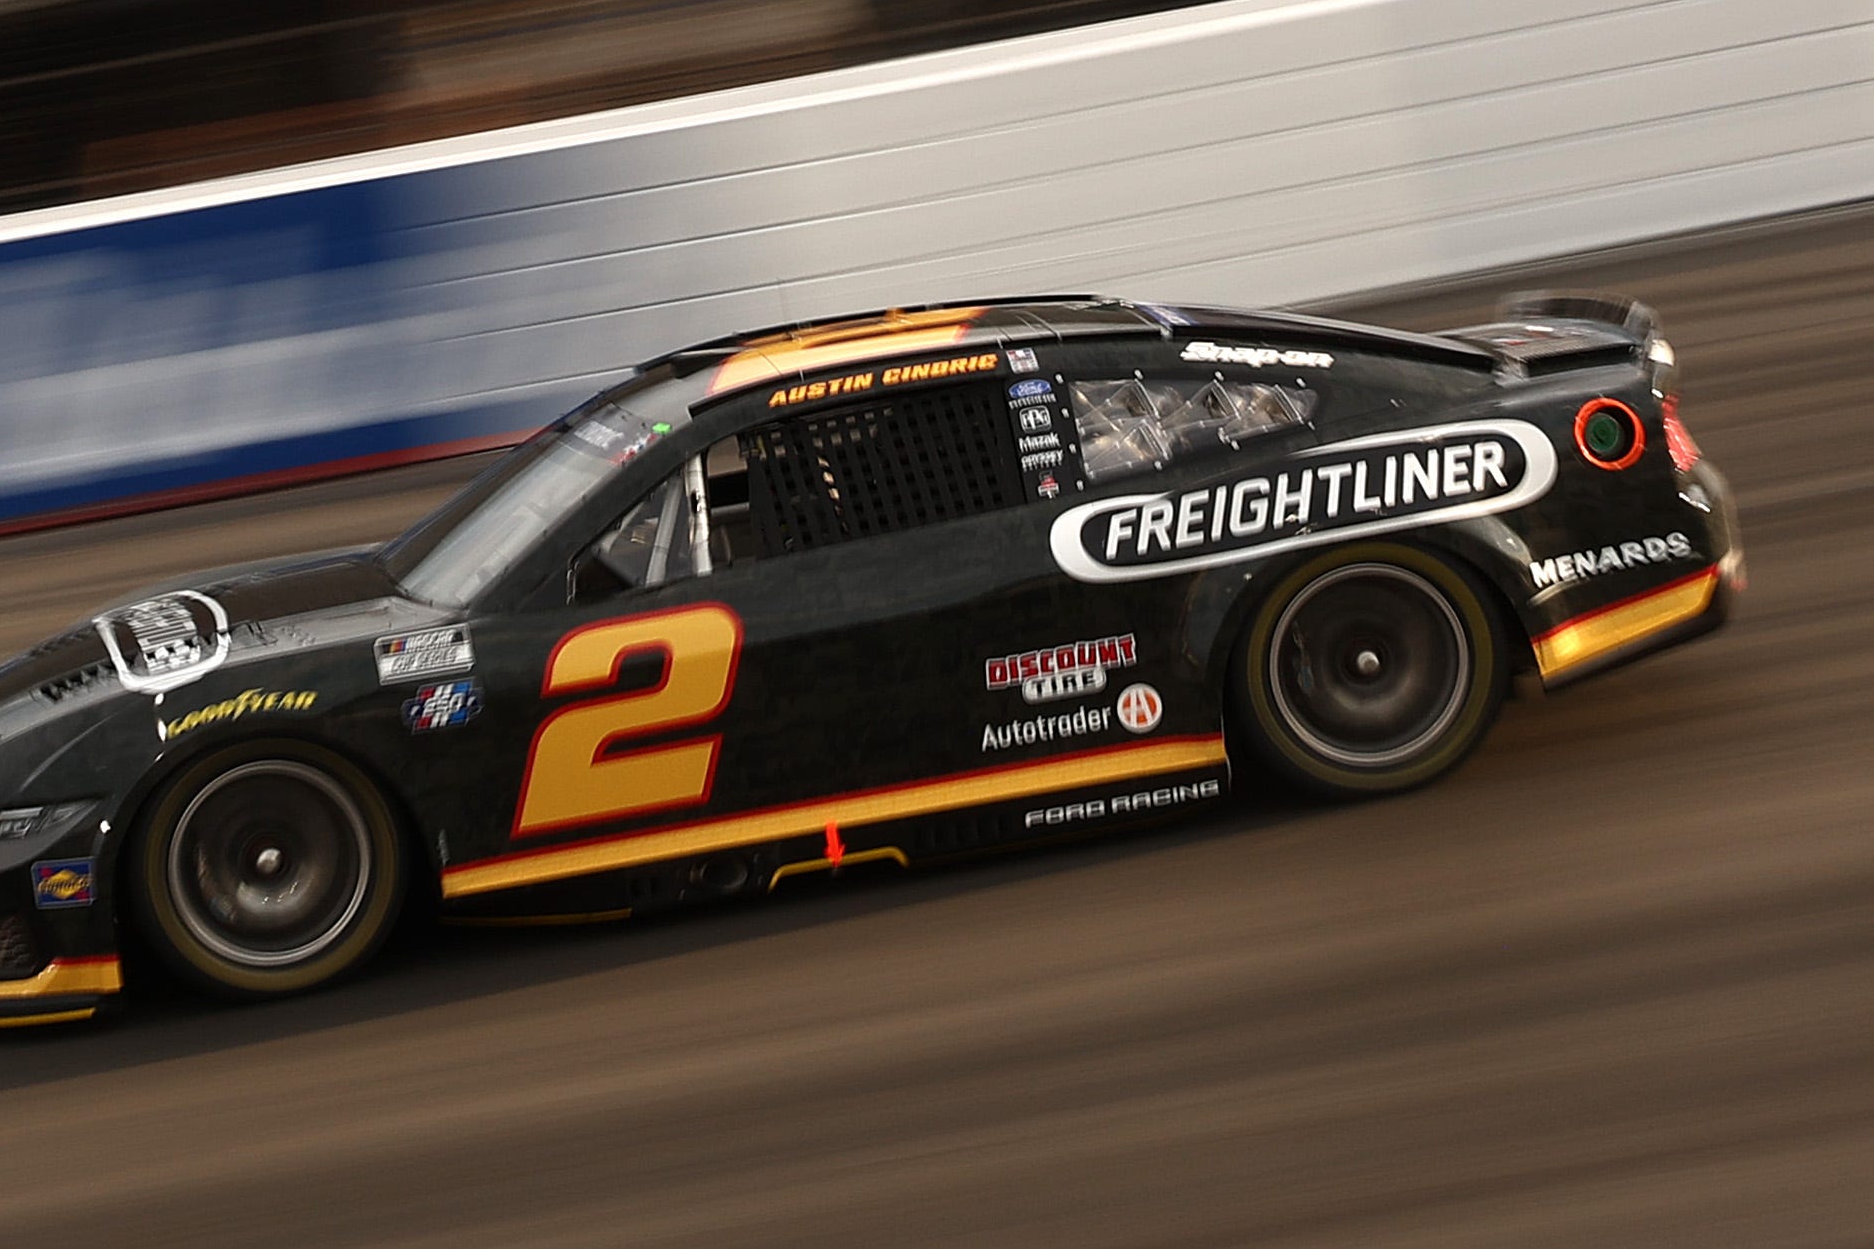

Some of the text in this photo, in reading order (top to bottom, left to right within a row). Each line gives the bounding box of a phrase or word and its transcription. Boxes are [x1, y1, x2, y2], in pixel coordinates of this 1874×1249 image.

[768, 353, 998, 408] AUSTIN CINDRIC
[1105, 440, 1507, 559] FREIGHTLINER
[1529, 532, 1692, 588] MENARDS
[986, 633, 1137, 690] DISCOUNT
[1031, 669, 1097, 700] TIRE
[167, 687, 319, 739] GOODYEAR
[510, 600, 744, 839] 2
[981, 705, 1112, 752] Autotrader
[1025, 779, 1220, 828] FORD RACING
